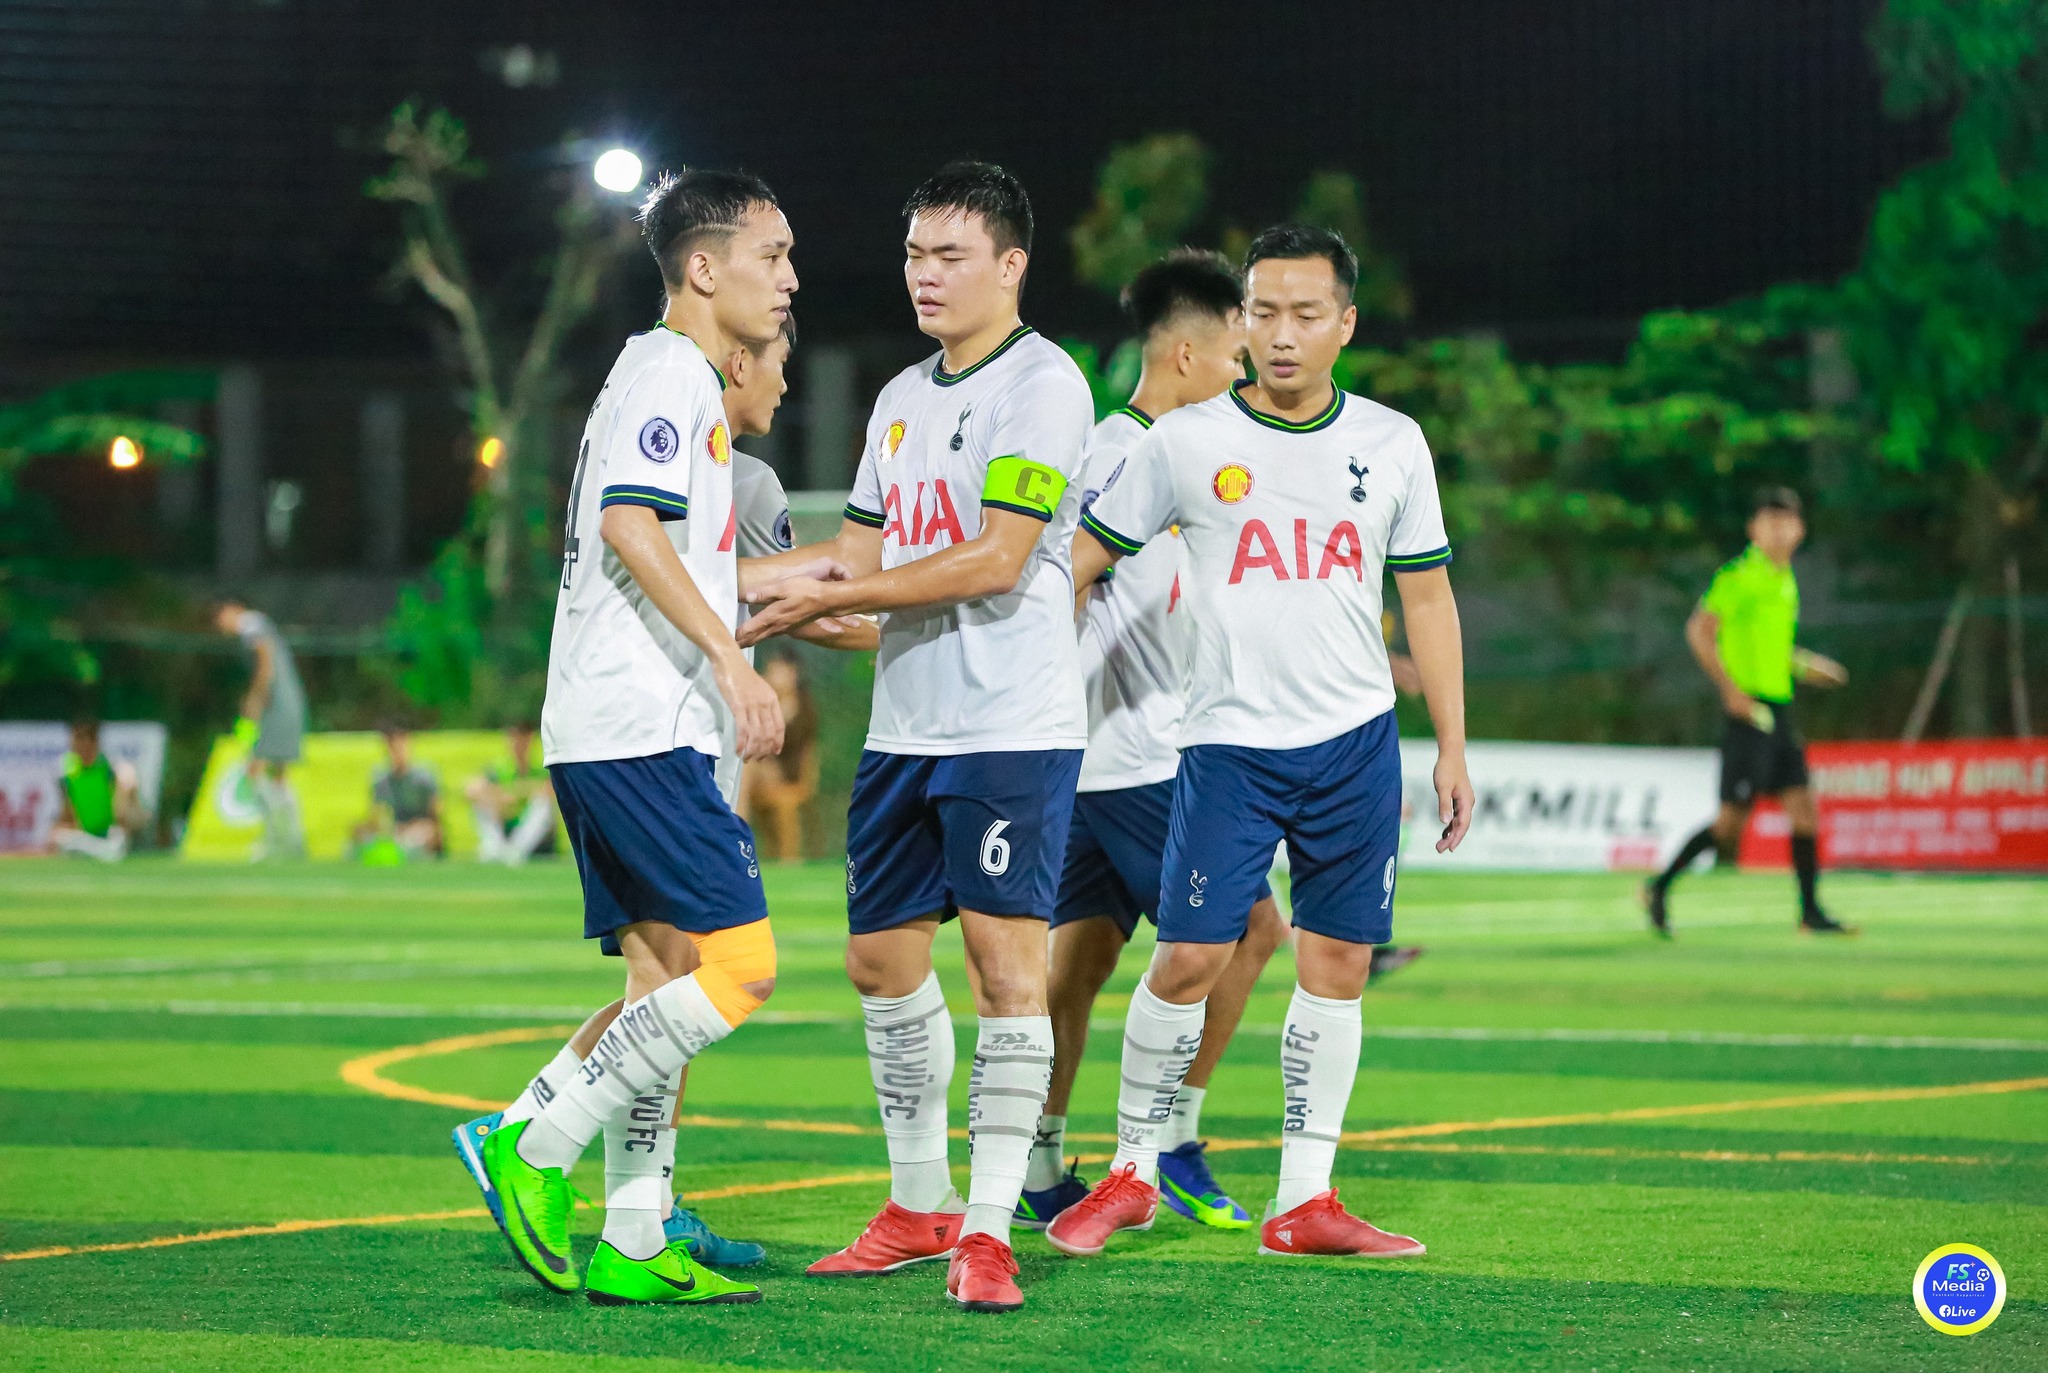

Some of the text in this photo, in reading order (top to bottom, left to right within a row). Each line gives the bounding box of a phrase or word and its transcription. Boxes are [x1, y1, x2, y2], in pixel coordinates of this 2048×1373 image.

[1015, 466, 1052, 505] C
[883, 478, 966, 546] AIA
[1227, 518, 1363, 585] AIA
[979, 819, 1012, 876] 6
[1380, 856, 1396, 910] 9
[1286, 1024, 1320, 1054] FC
[884, 1092, 921, 1120] FC
[624, 1127, 658, 1154] FC
